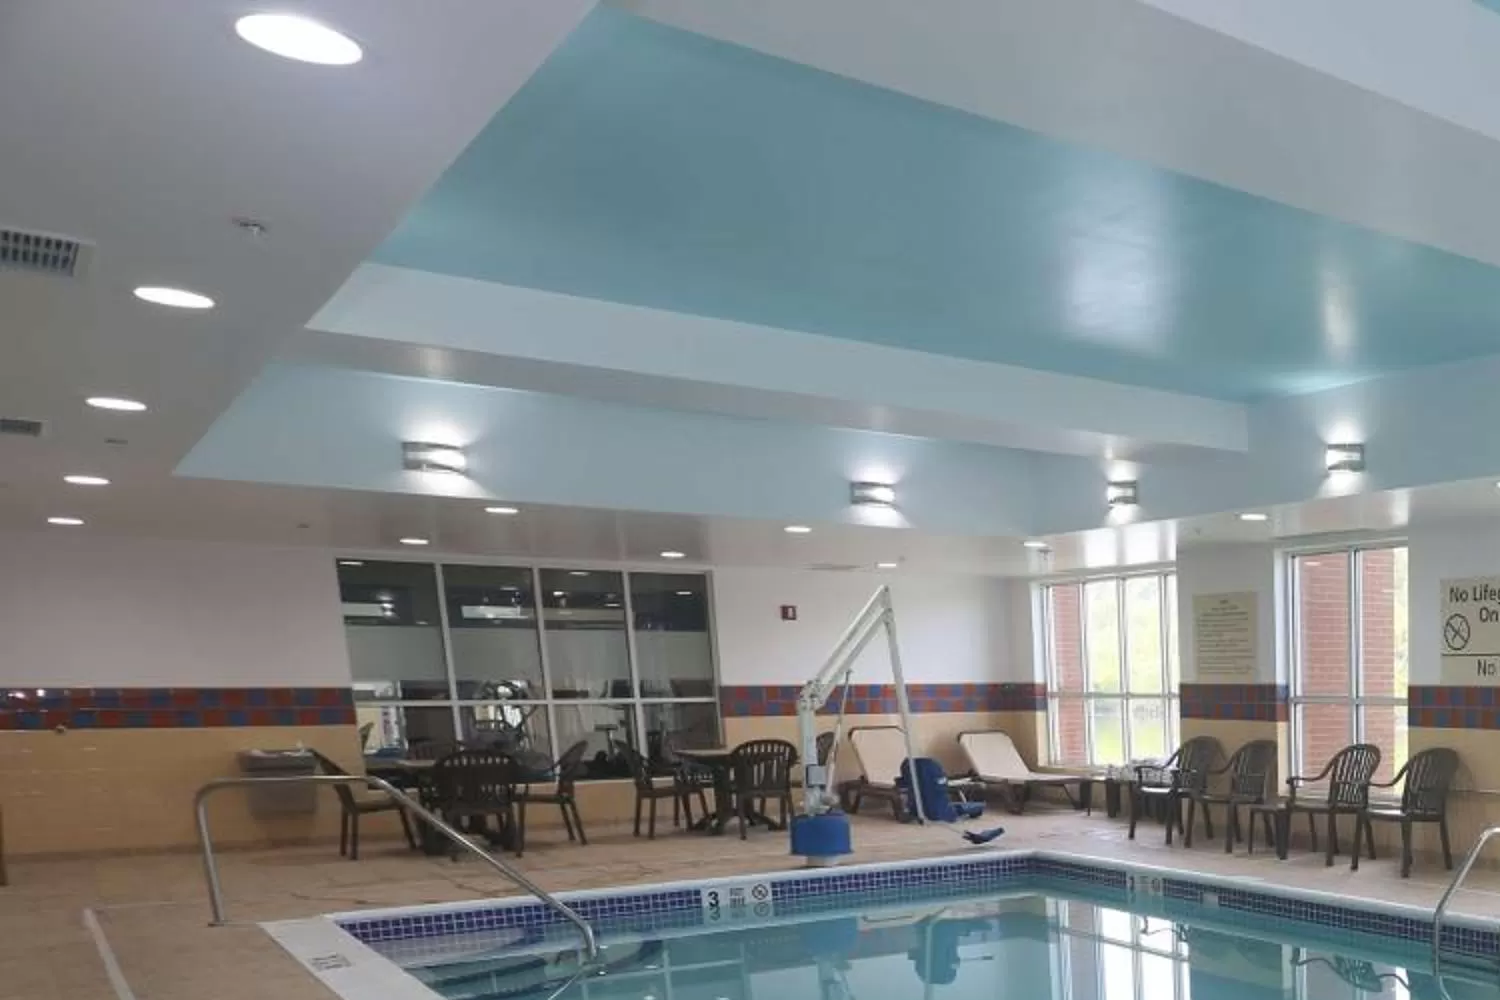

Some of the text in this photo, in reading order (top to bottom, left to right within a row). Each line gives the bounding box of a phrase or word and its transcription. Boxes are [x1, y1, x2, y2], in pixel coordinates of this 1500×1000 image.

[1449, 587, 1469, 602] No
[1479, 606, 1499, 623] On
[1477, 659, 1496, 677] No
[707, 891, 719, 908] 3
